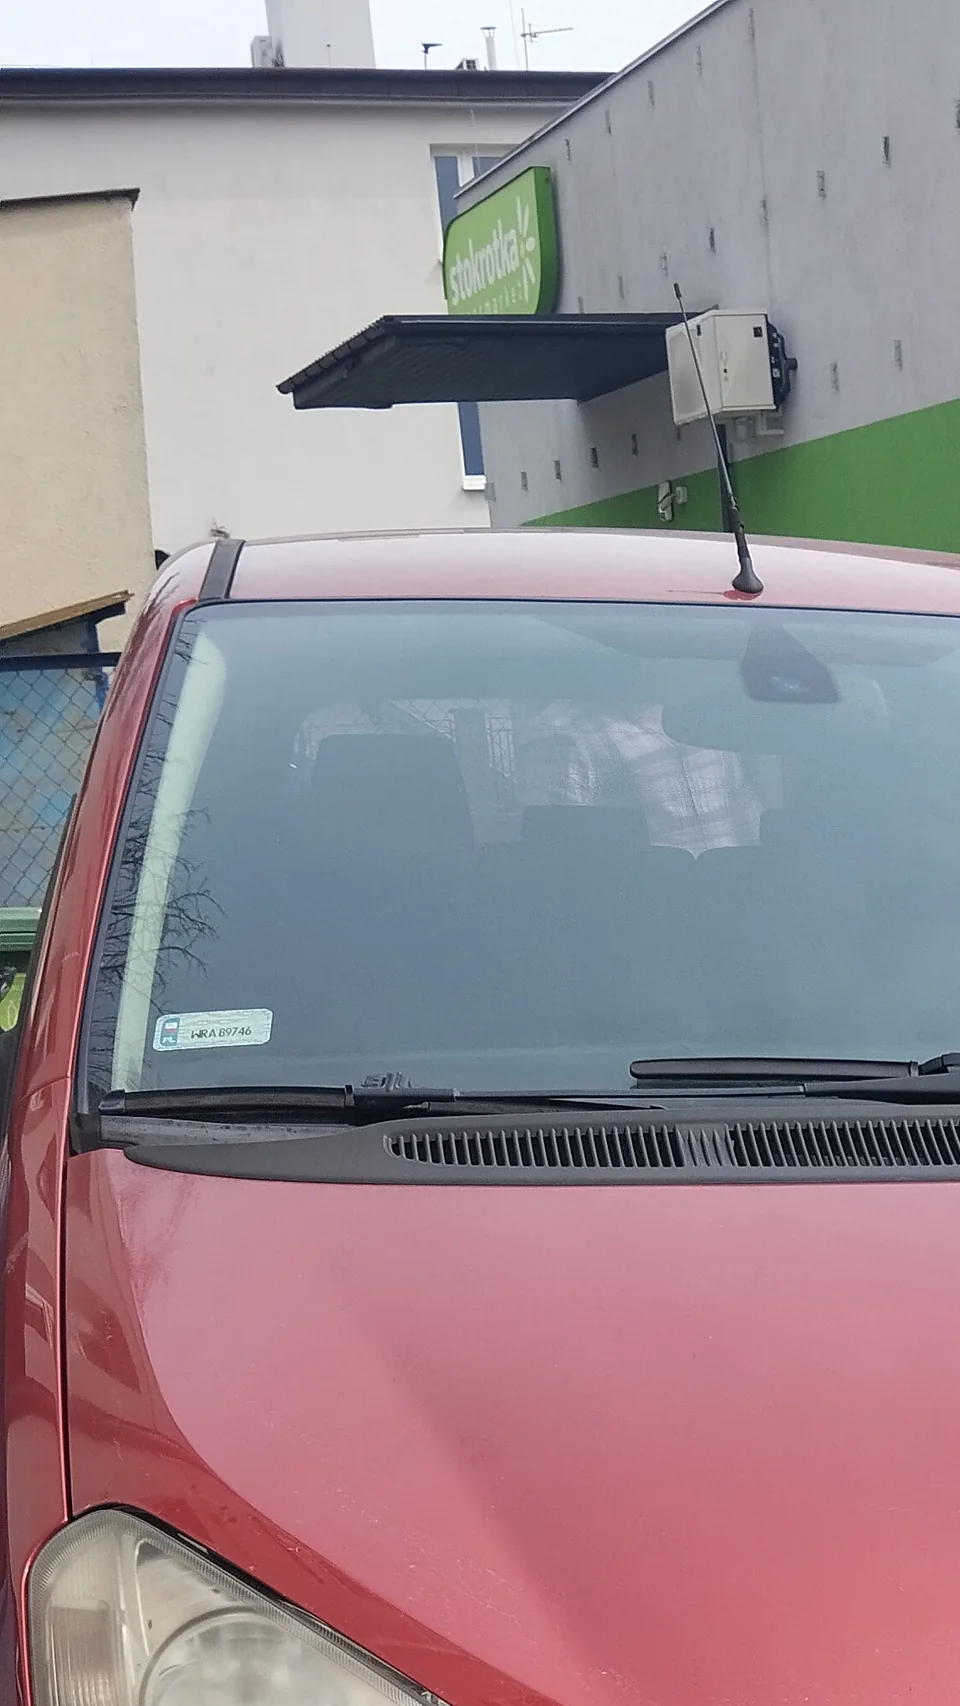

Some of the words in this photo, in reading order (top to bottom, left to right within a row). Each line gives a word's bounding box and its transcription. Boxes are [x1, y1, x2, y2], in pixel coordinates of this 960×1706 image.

[450, 219, 520, 306] stokrotka
[190, 1028, 217, 1039] WRA
[218, 1026, 252, 1037] 89746
